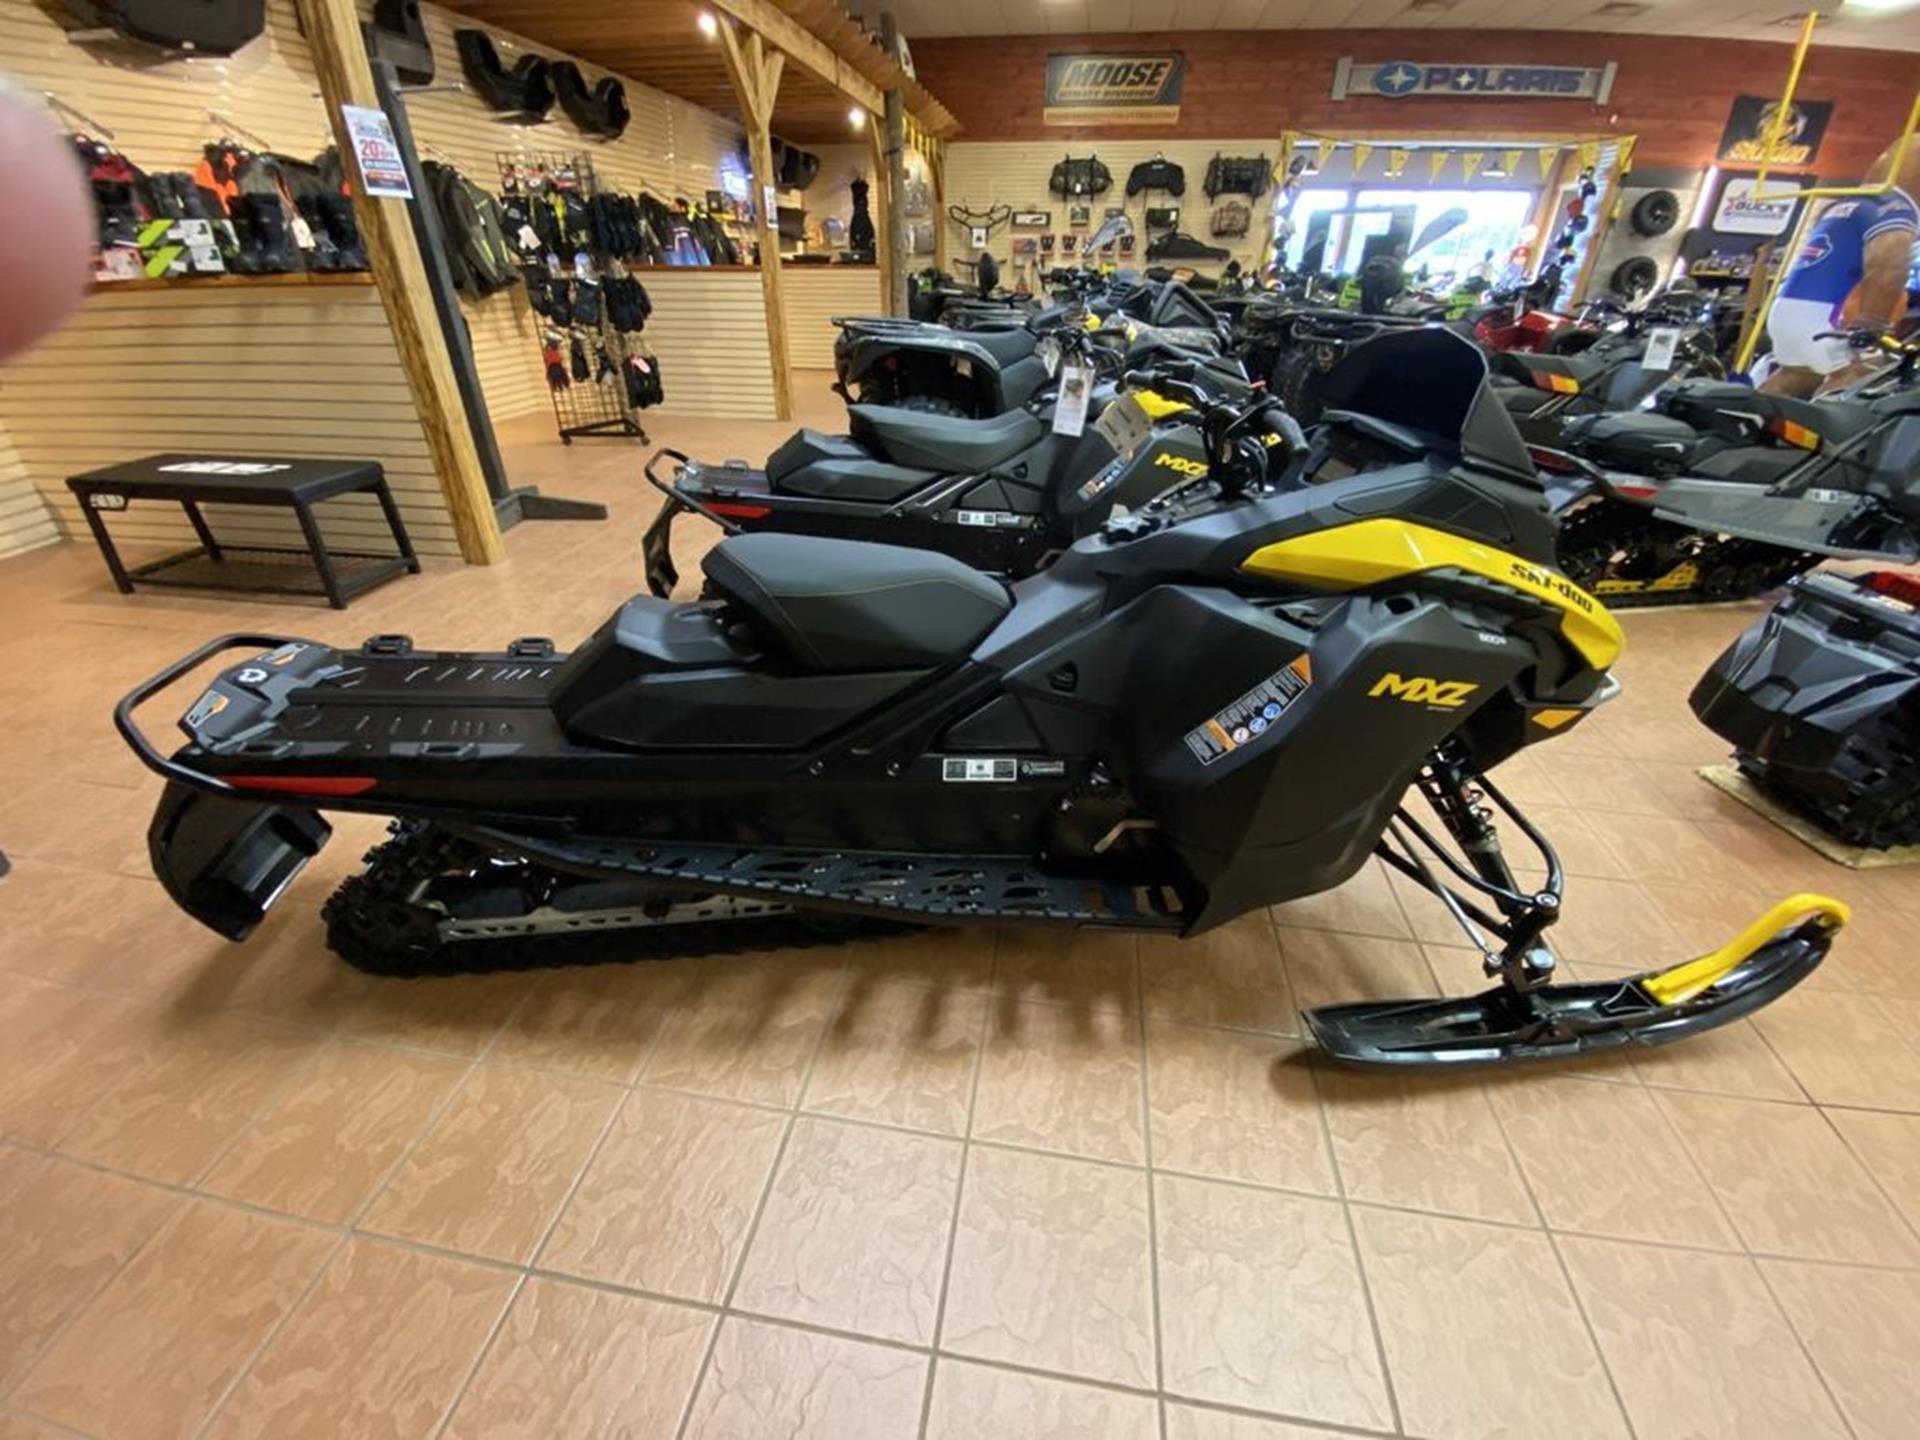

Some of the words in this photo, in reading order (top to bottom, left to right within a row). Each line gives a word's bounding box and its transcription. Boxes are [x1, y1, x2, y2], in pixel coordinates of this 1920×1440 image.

[1064, 62, 1168, 87] MOOSE
[1425, 67, 1586, 93] POLARIS
[1367, 672, 1479, 707] MXZ
